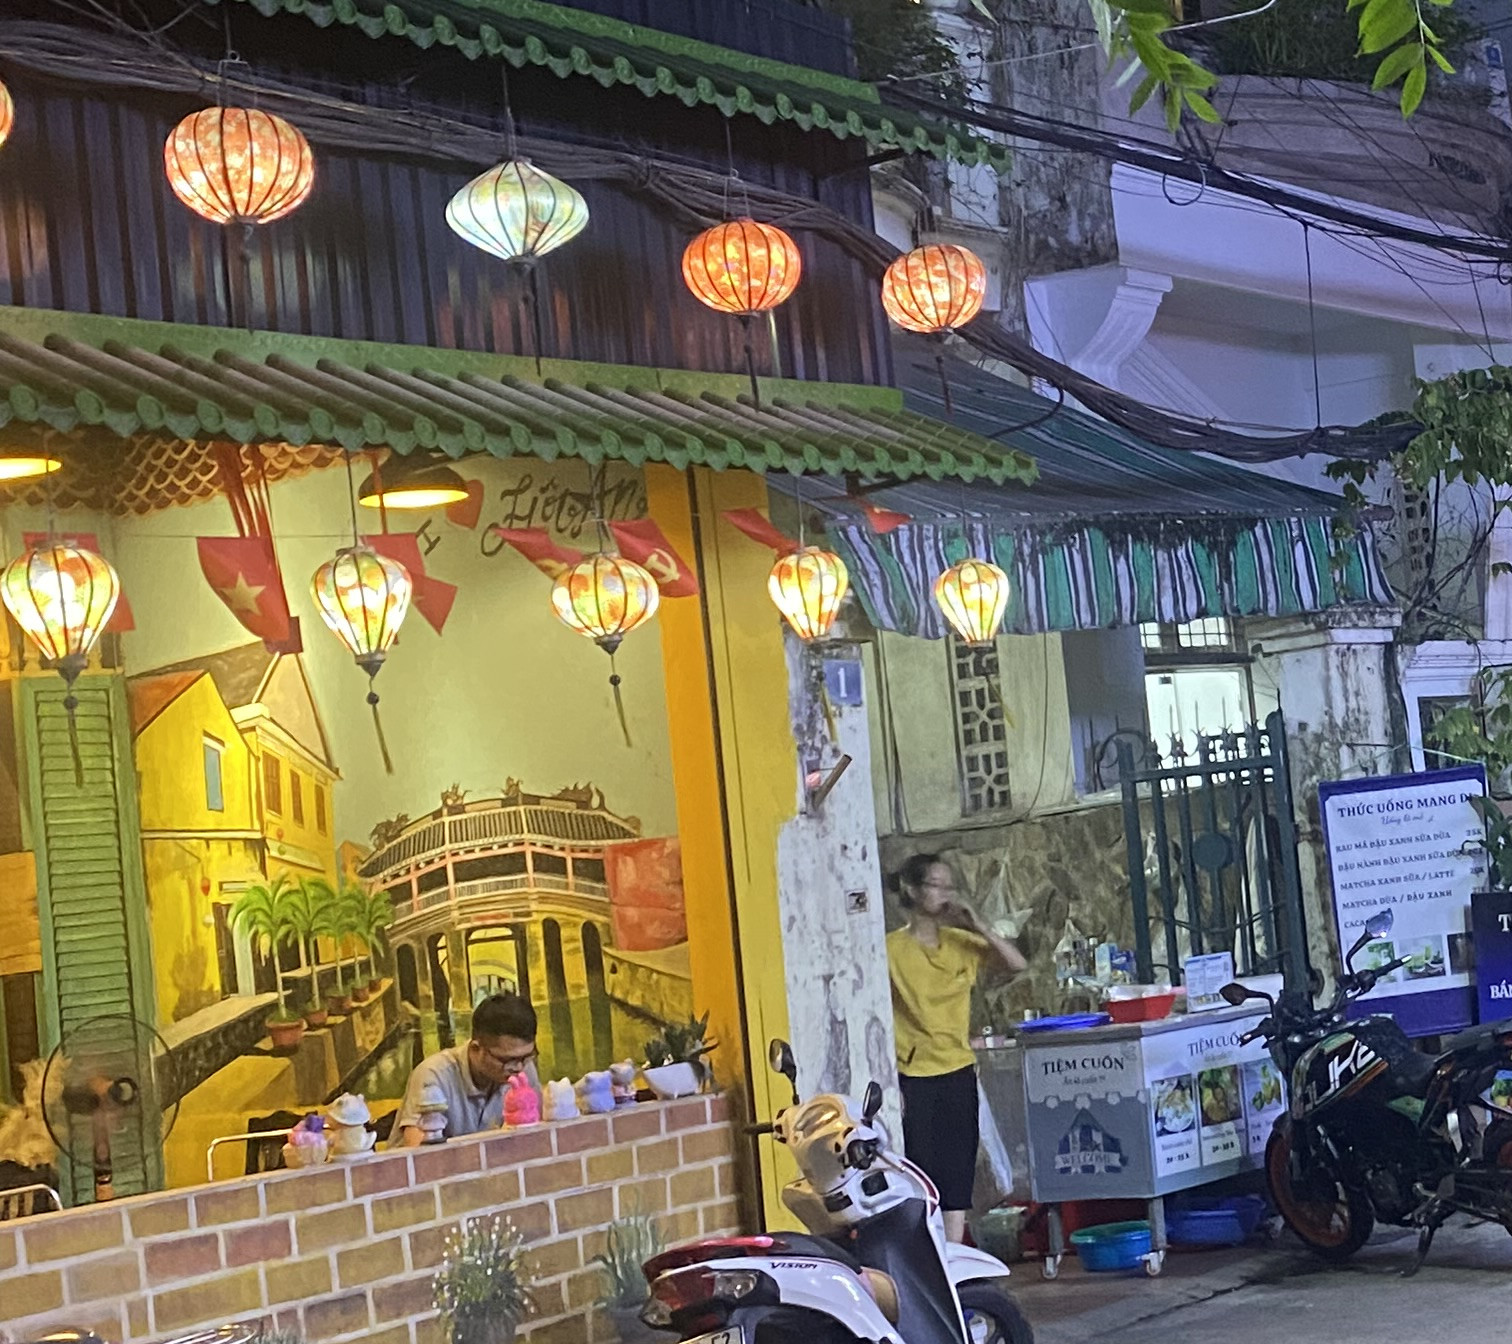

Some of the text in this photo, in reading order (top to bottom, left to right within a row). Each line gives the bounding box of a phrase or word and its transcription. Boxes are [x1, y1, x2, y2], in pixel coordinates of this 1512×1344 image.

[838, 668, 847, 697] 1
[1338, 801, 1374, 818] THỨC
[1378, 796, 1413, 814] UỐNG
[1418, 794, 1456, 809] MANG
[1389, 835, 1413, 846] XANH
[1402, 853, 1426, 863] XANH
[1340, 879, 1376, 891] MATCHA
[1377, 876, 1402, 886] XANH
[1342, 898, 1377, 910] MATCHA
[1427, 889, 1452, 899] XANH
[1188, 1038, 1214, 1056] TIỆM
[1042, 1055, 1124, 1075] TIỆM CUỐN
